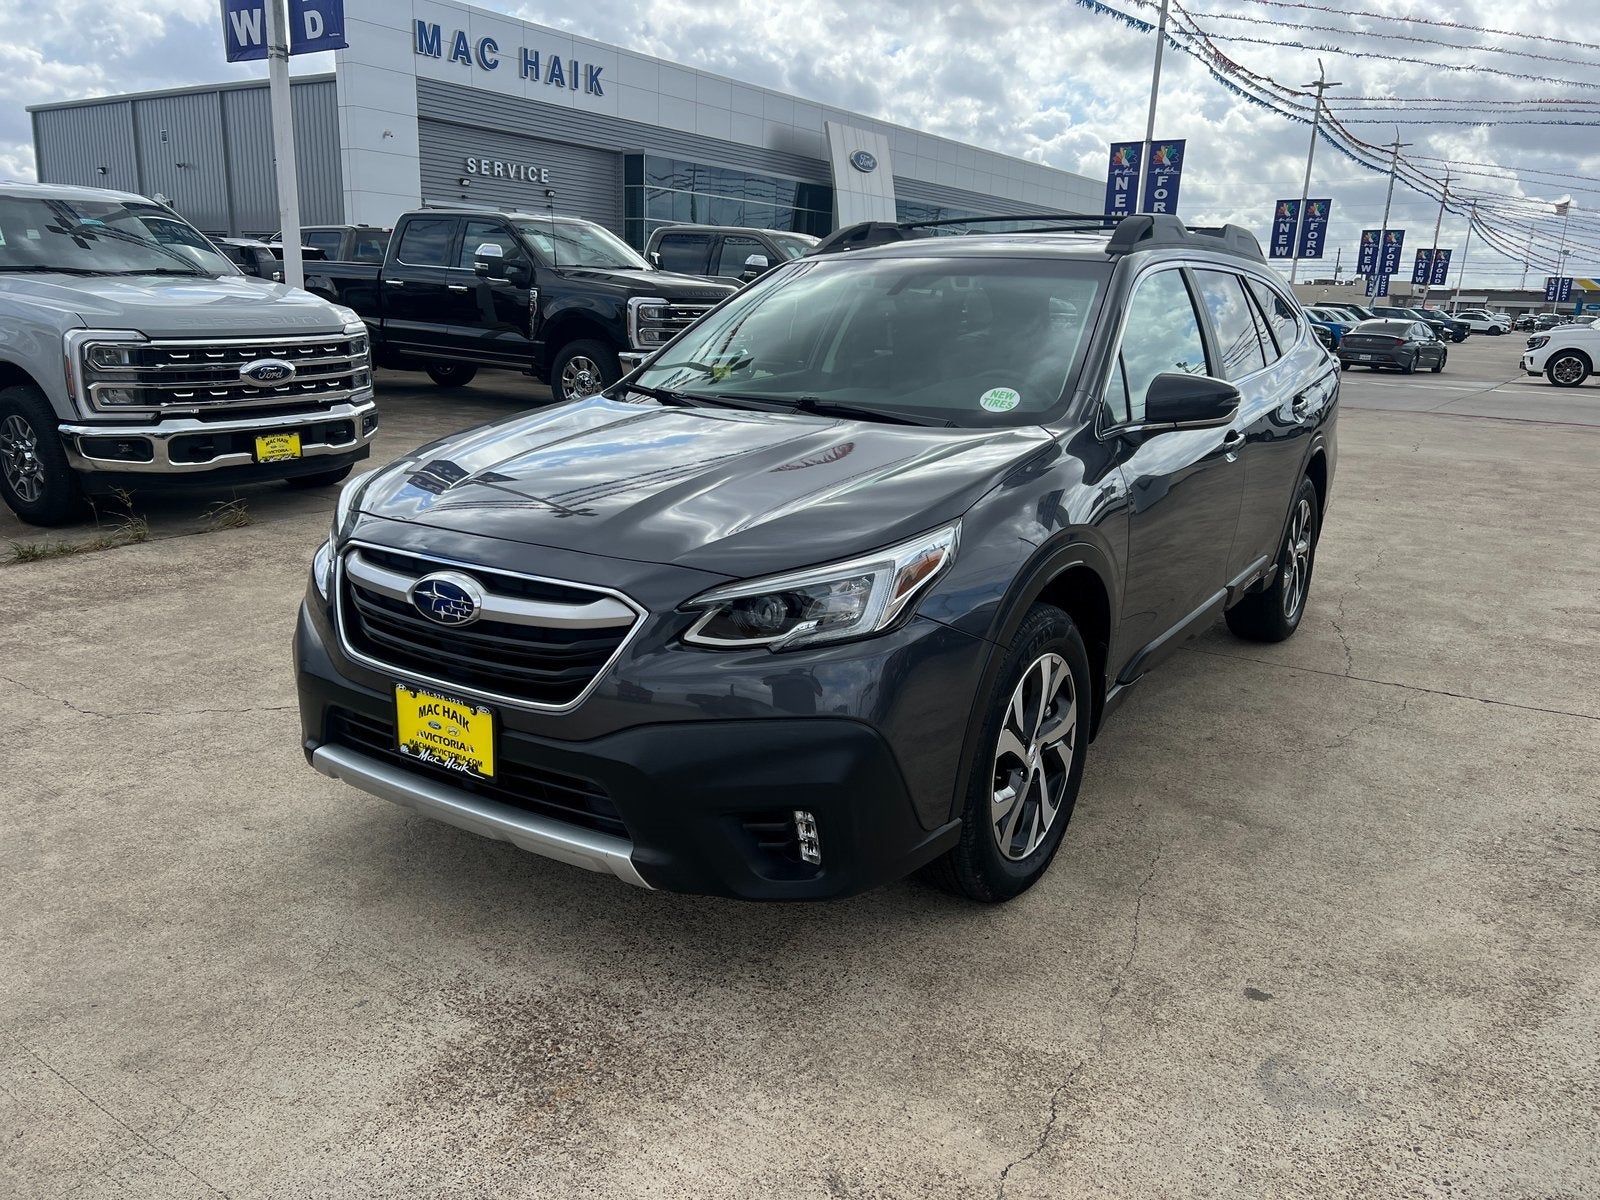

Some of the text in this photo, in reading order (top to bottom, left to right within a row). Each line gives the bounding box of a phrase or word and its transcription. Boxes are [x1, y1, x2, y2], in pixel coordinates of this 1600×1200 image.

[414, 19, 606, 96] MAC HAIK
[465, 157, 551, 184] SERVICE
[1275, 223, 1290, 256] NEW
[1305, 222, 1319, 257] FORD
[1361, 247, 1373, 273] NEW
[1384, 247, 1396, 273] FORD
[1415, 262, 1426, 283] NEW
[1434, 262, 1444, 284] FORD
[1547, 286, 1555, 301] NEW
[258, 365, 284, 380] Ford
[982, 397, 1014, 409] TIRES
[990, 390, 1016, 401] NEW
[265, 437, 289, 447] MAC HAIK
[418, 704, 440, 719] MAC
[442, 706, 470, 733] HAIK
[423, 730, 467, 752] VICTORIA
[418, 748, 474, 773] Mac Haik
